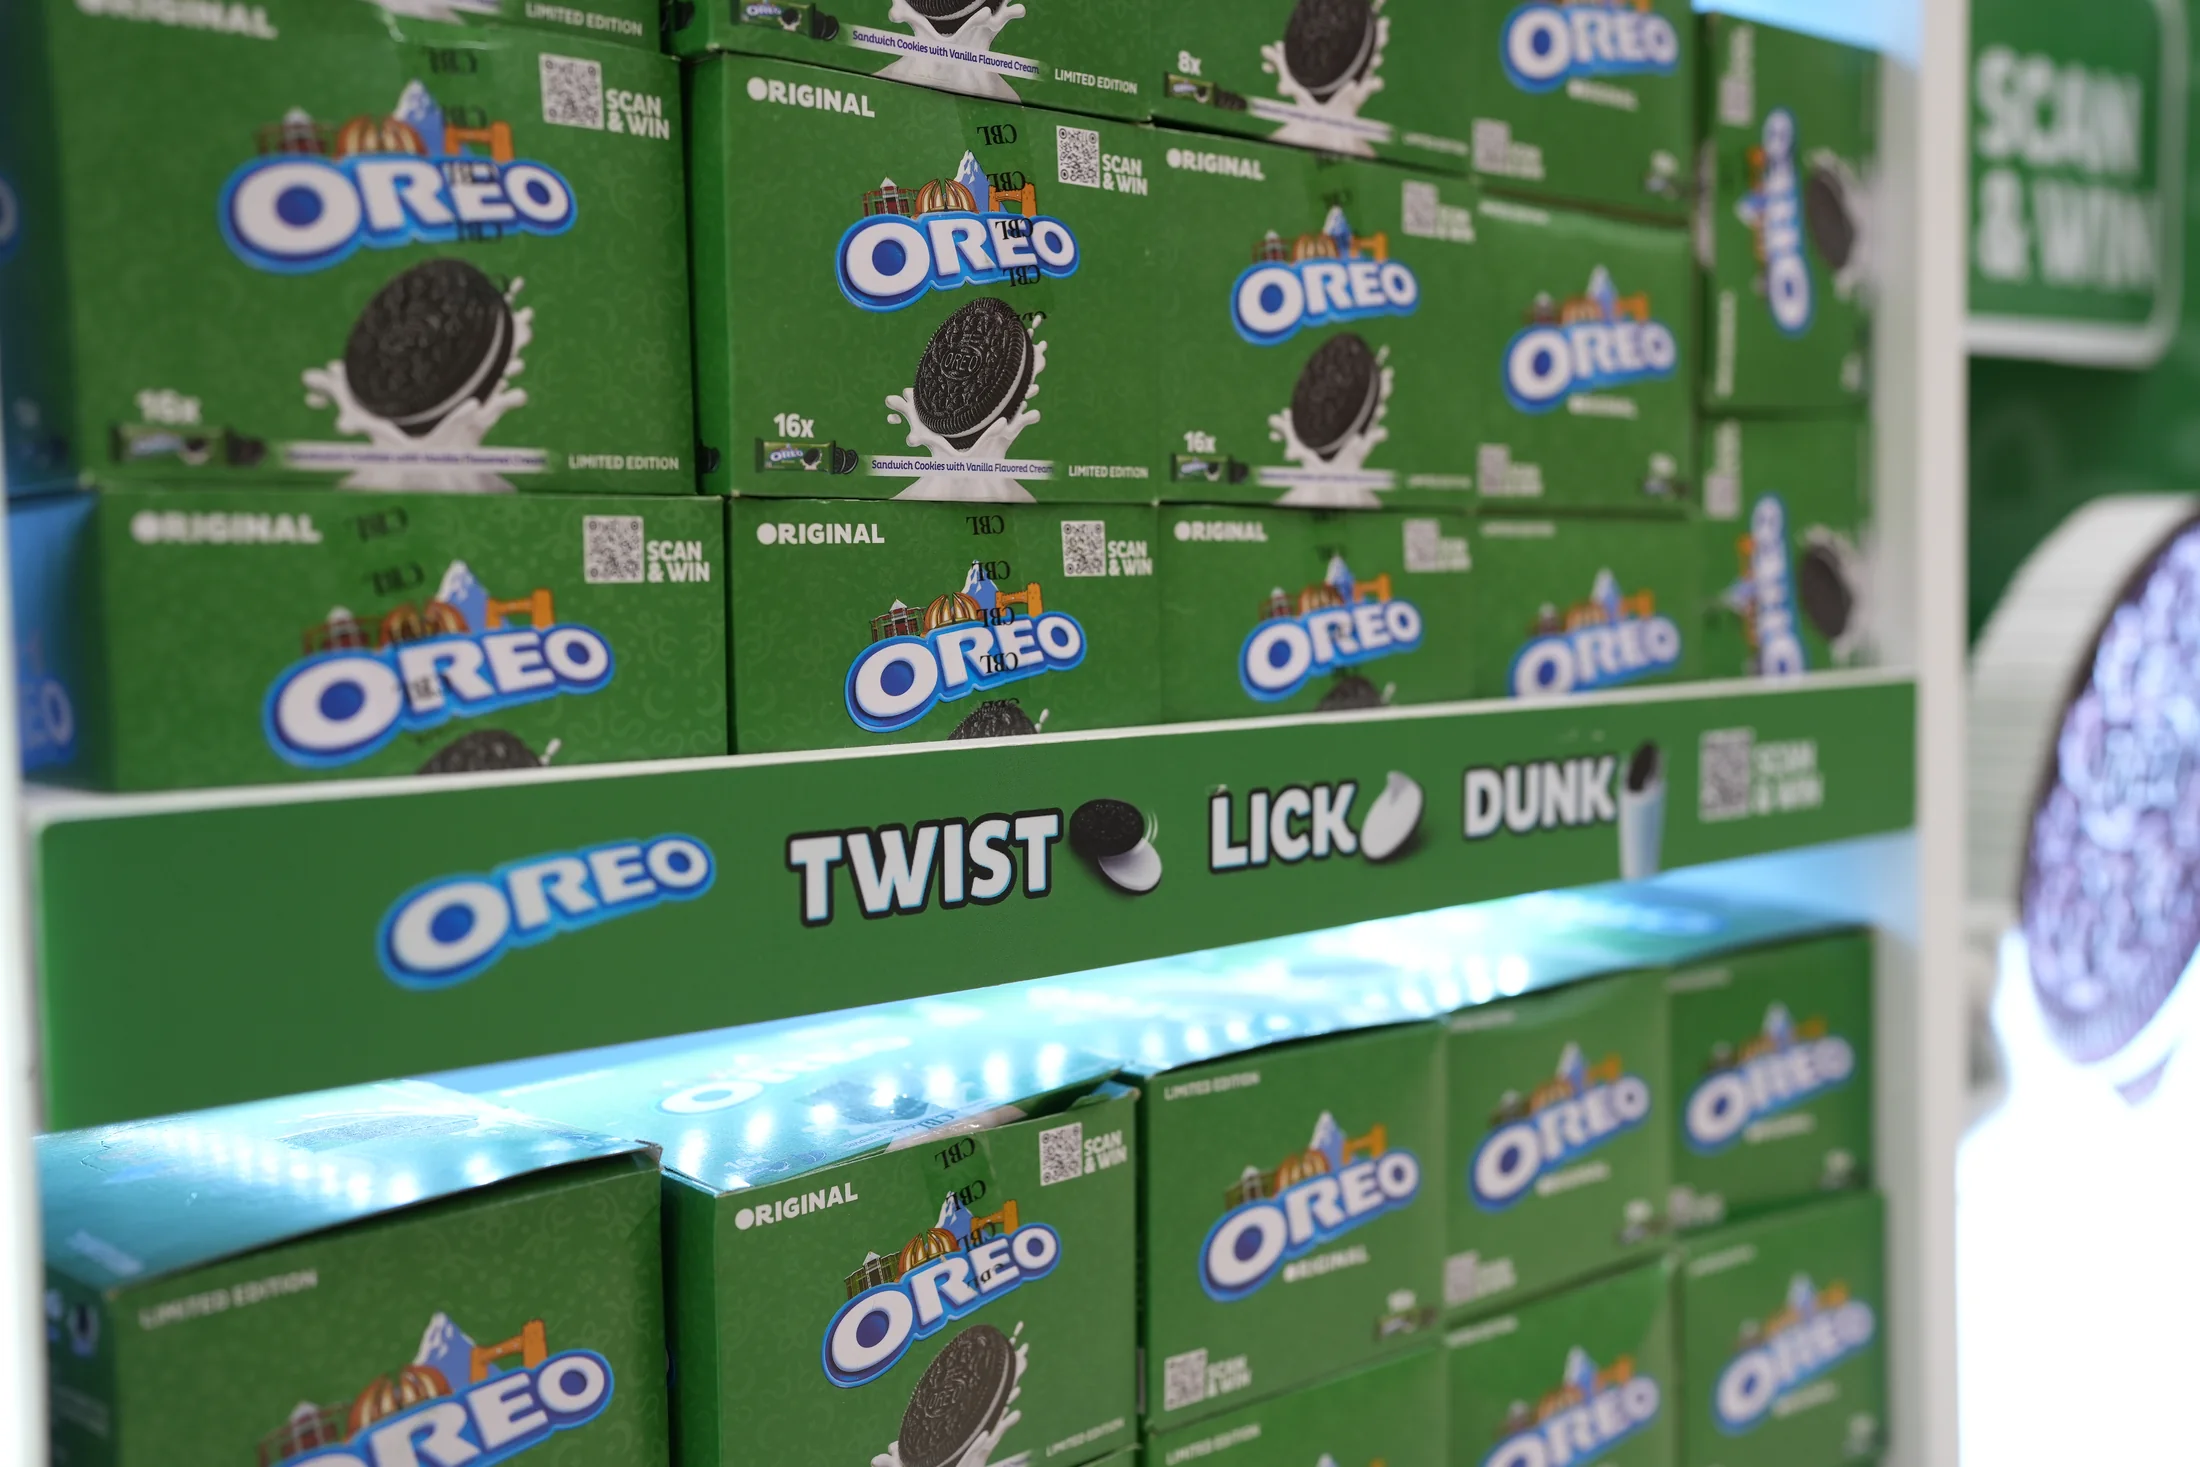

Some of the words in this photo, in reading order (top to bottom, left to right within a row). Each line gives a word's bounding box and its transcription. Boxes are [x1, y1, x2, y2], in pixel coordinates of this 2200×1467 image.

[525, 1, 585, 26] LIMITED
[586, 14, 643, 36] EDITION
[852, 30, 896, 48] Sandwich
[897, 38, 928, 53] Cookies
[929, 45, 948, 57] with
[949, 49, 977, 63] Vanilla
[978, 53, 1014, 70] Flavored
[1014, 60, 1040, 75] Cream
[1176, 50, 1202, 77] 8x
[746, 76, 876, 118] ORIGINAL
[1054, 67, 1096, 88] LIMITED
[1096, 75, 1138, 95] EDITION
[605, 88, 662, 118] SCAN
[1976, 43, 2142, 176] SCAN
[607, 109, 625, 134] &
[627, 113, 671, 141] WIN
[976, 123, 1018, 146] CBL
[1102, 153, 1143, 177] SCAN
[1166, 147, 1266, 181] ORIGINAL
[1102, 172, 1115, 192] &
[1115, 174, 1149, 197] WIN
[226, 156, 573, 264] OREO
[2030, 177, 2161, 289] WIN
[840, 215, 1078, 305] OREO
[1235, 259, 1418, 339] OREO
[1506, 321, 1676, 405] OREO
[773, 412, 815, 438] 16x
[1184, 430, 1217, 453] 16x
[568, 454, 624, 470] LIMITED
[625, 455, 680, 471] EDITION
[871, 459, 914, 471] Sandwich
[914, 460, 945, 472] Cookies
[946, 461, 965, 472] with
[966, 461, 994, 473] Vanilla
[994, 462, 1028, 474] Flavored
[1029, 463, 1055, 475] Cream
[1068, 464, 1108, 478] LIMITED
[1109, 465, 1149, 479] EDITION
[130, 508, 324, 546] ORIGINAL
[756, 522, 885, 545] ORIGINAL
[965, 514, 1005, 536] CBL
[1173, 520, 1268, 543] ORIGINAL
[646, 539, 702, 561] SCAN
[1106, 540, 1148, 559] SCAN
[647, 561, 665, 583] &
[665, 561, 711, 583] WIN
[1107, 558, 1121, 577] &
[1121, 557, 1154, 577] WIN
[1243, 598, 1423, 695] OREO
[850, 613, 1082, 726] OREO
[269, 626, 612, 759] OREO
[1463, 754, 1619, 841] DUNK
[1209, 781, 1359, 871] LICK
[788, 812, 1060, 924] TWIST
[385, 835, 712, 982] OREO
[934, 1136, 976, 1171] CBL
[1083, 1129, 1123, 1157] SCAN
[1096, 1144, 1128, 1170] WIN
[734, 1181, 859, 1231] ORIGINAL
[945, 1178, 988, 1212] CBL
[1203, 1151, 1420, 1294] OREO
[826, 1225, 1059, 1380] OREO
[282, 1352, 609, 1467] REO
